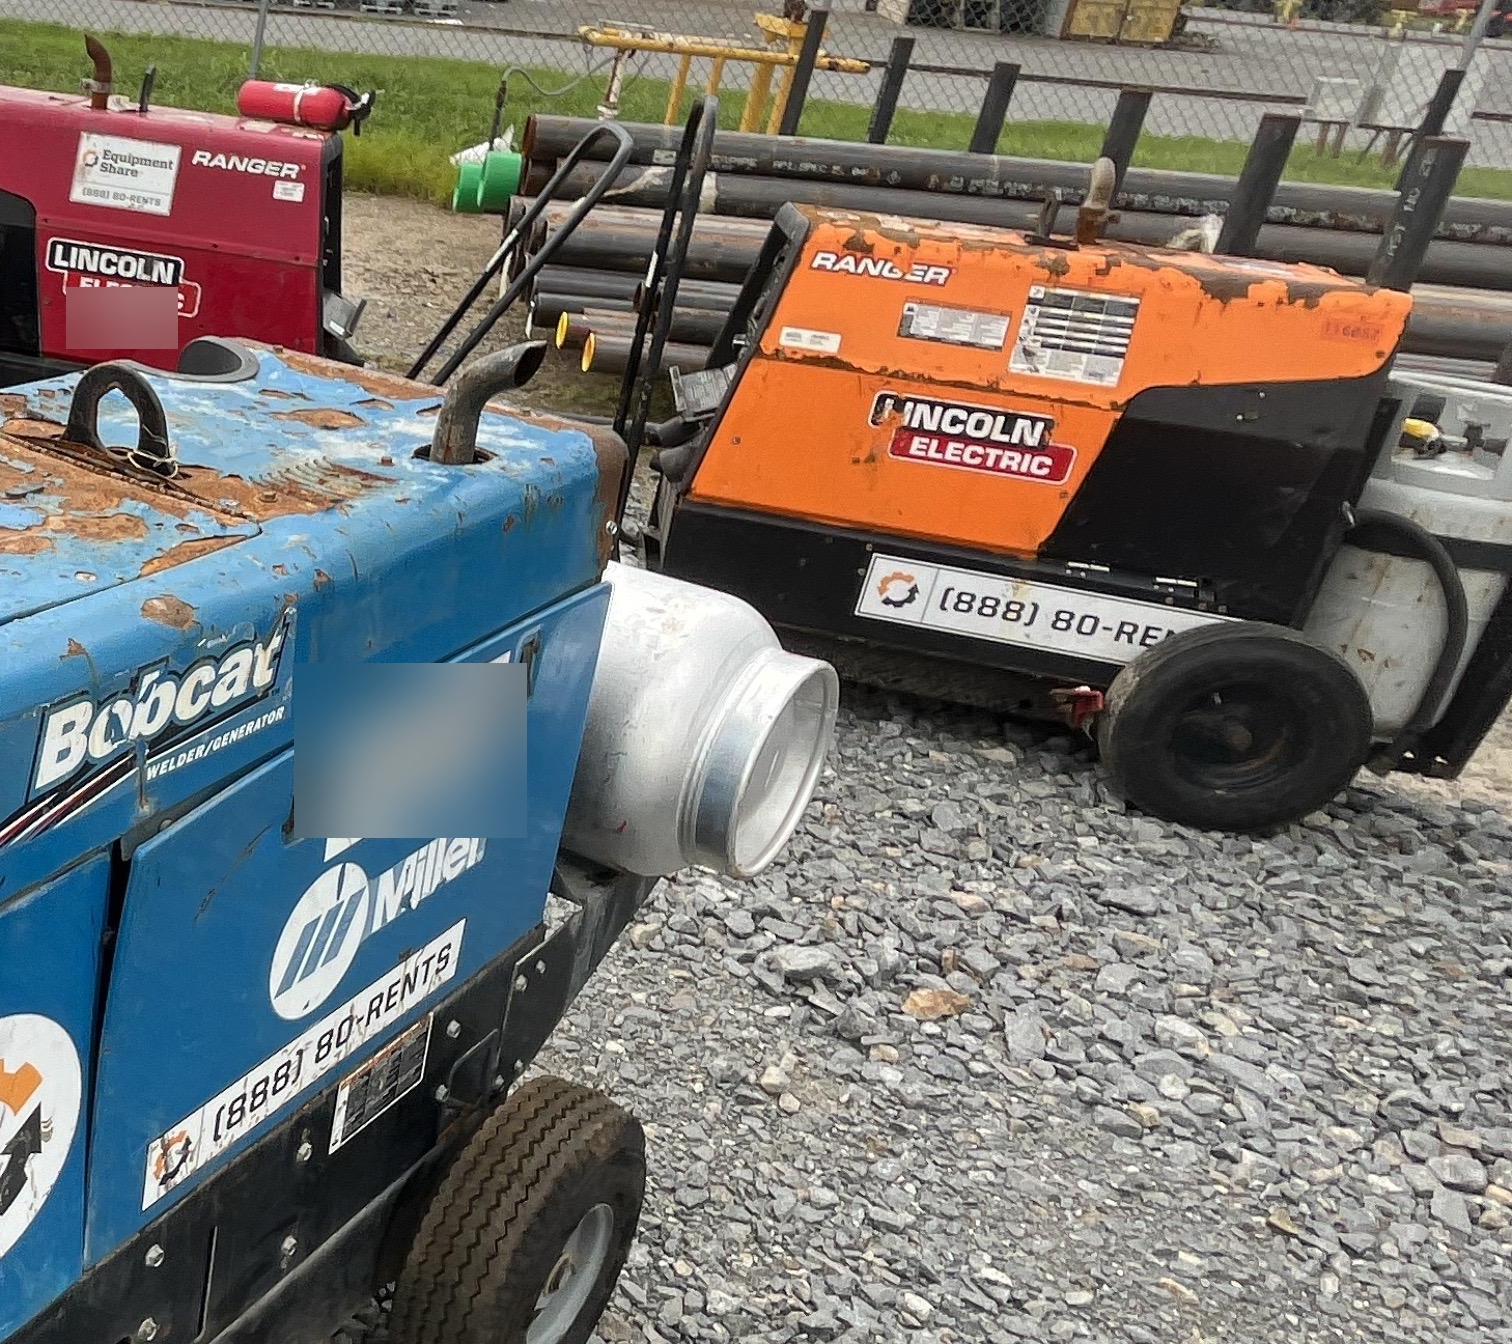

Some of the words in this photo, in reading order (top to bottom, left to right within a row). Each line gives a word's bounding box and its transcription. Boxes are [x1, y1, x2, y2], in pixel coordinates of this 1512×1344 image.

[99, 164, 138, 178] Share
[101, 149, 174, 171] Equipment
[191, 150, 301, 178] RANGER
[54, 244, 175, 285] LINCOLN
[908, 436, 1053, 476] ELECTRIC
[939, 587, 1040, 627] (888)
[35, 627, 285, 791] Bobcat
[146, 705, 286, 781] WELDER/GENERATOR
[370, 838, 486, 933] Miller
[212, 1048, 305, 1142] (888)
[314, 942, 452, 1064] 80-RENTS
